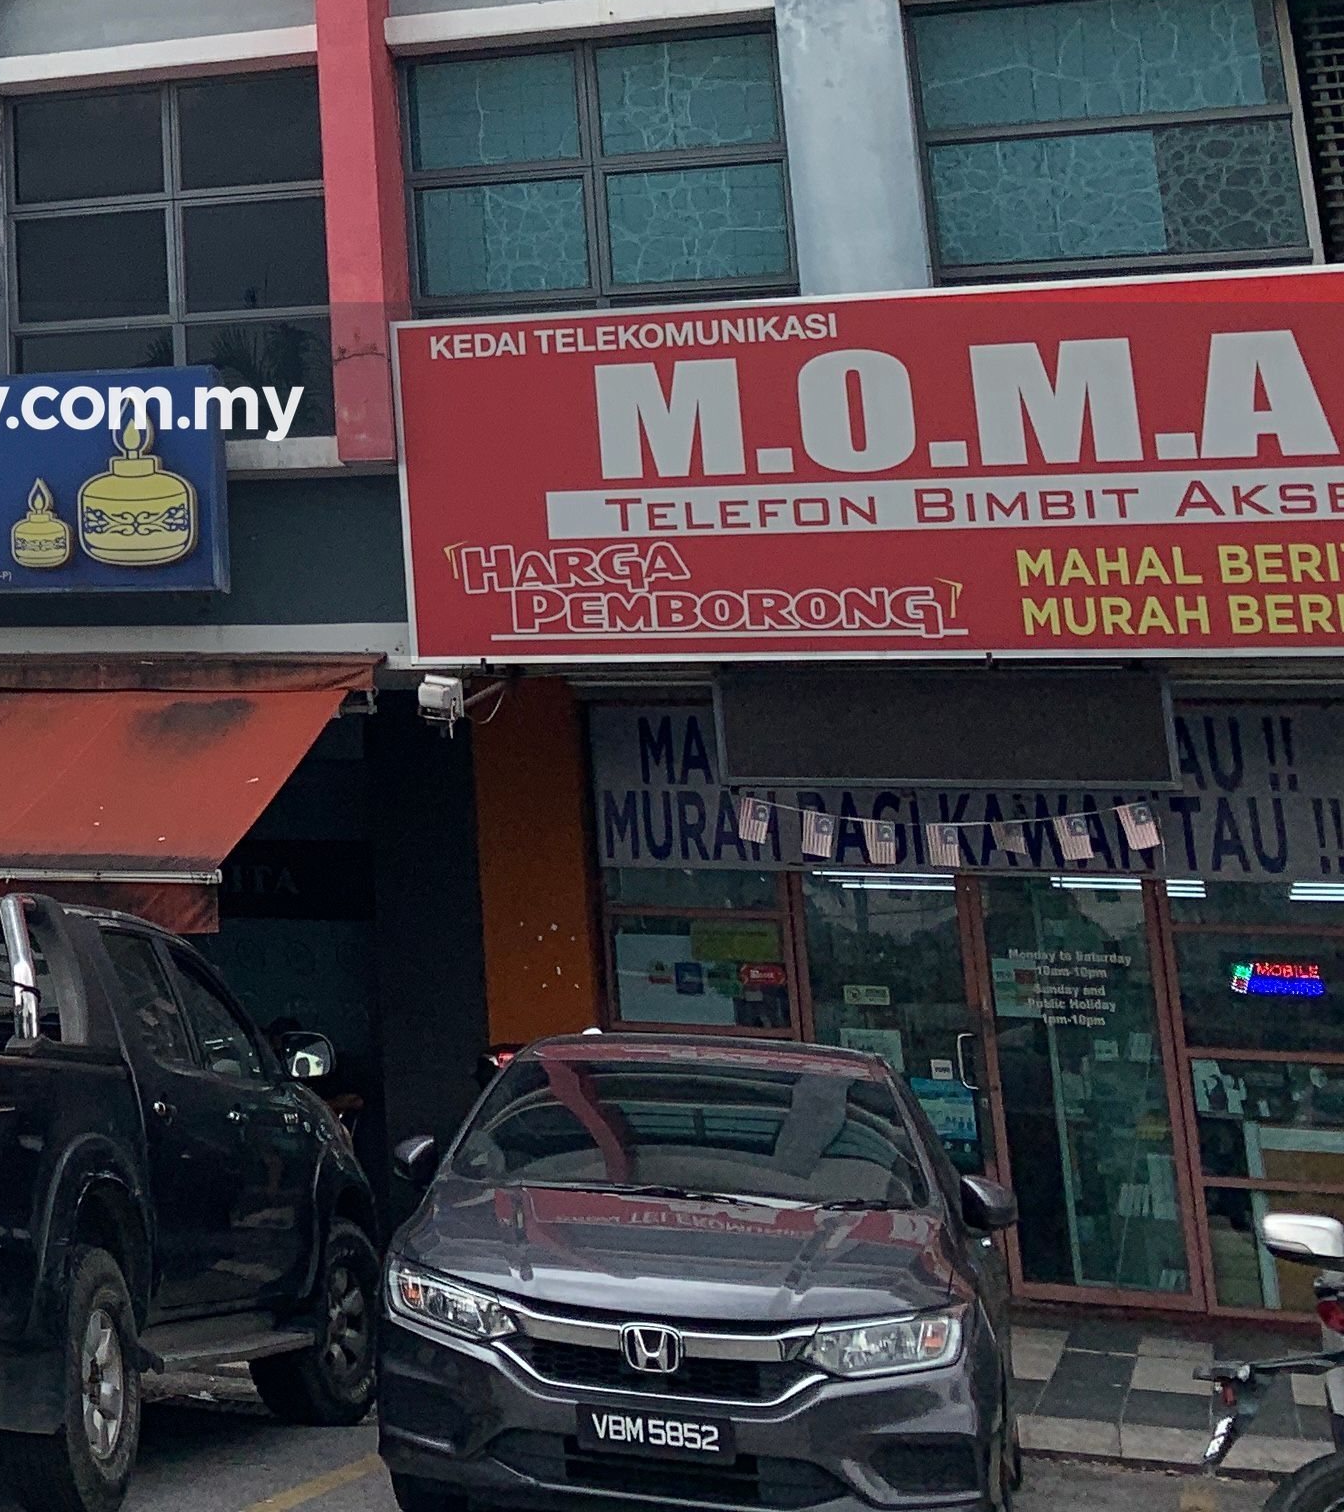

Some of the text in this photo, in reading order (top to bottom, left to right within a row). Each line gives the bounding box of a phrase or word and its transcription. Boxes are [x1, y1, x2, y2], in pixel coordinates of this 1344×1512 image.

[429, 312, 838, 360] KEDAI TELEKOMUNIKASI
[594, 329, 1341, 480] M.O.M.A
[605, 496, 877, 533] TELEFON
[913, 487, 1140, 525] BIMBIT
[460, 541, 691, 595] HARGA
[1015, 541, 1344, 587] MAHAL BERI
[511, 586, 945, 639] PEMBORONG
[1021, 592, 1344, 637] MURAH BER
[637, 715, 713, 787] MA
[1173, 716, 1244, 792] AU
[1169, 796, 1290, 875] TAU
[1255, 962, 1320, 980] MOBILE
[590, 1412, 720, 1453] VBM 5852
